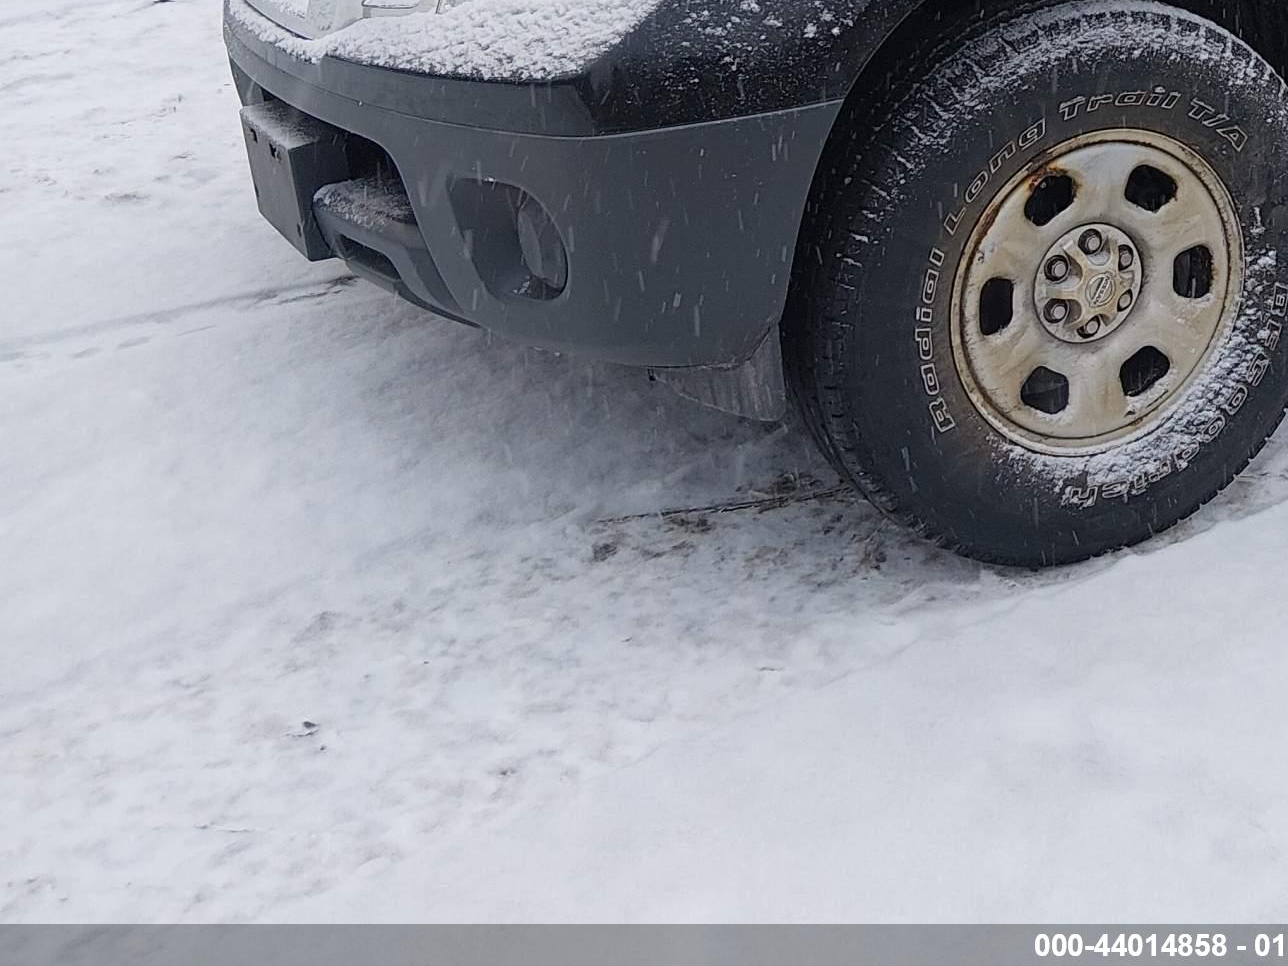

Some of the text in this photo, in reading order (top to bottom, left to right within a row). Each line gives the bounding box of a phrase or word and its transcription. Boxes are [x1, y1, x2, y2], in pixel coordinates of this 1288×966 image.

[914, 85, 1250, 434] Radial Long Trail T/A
